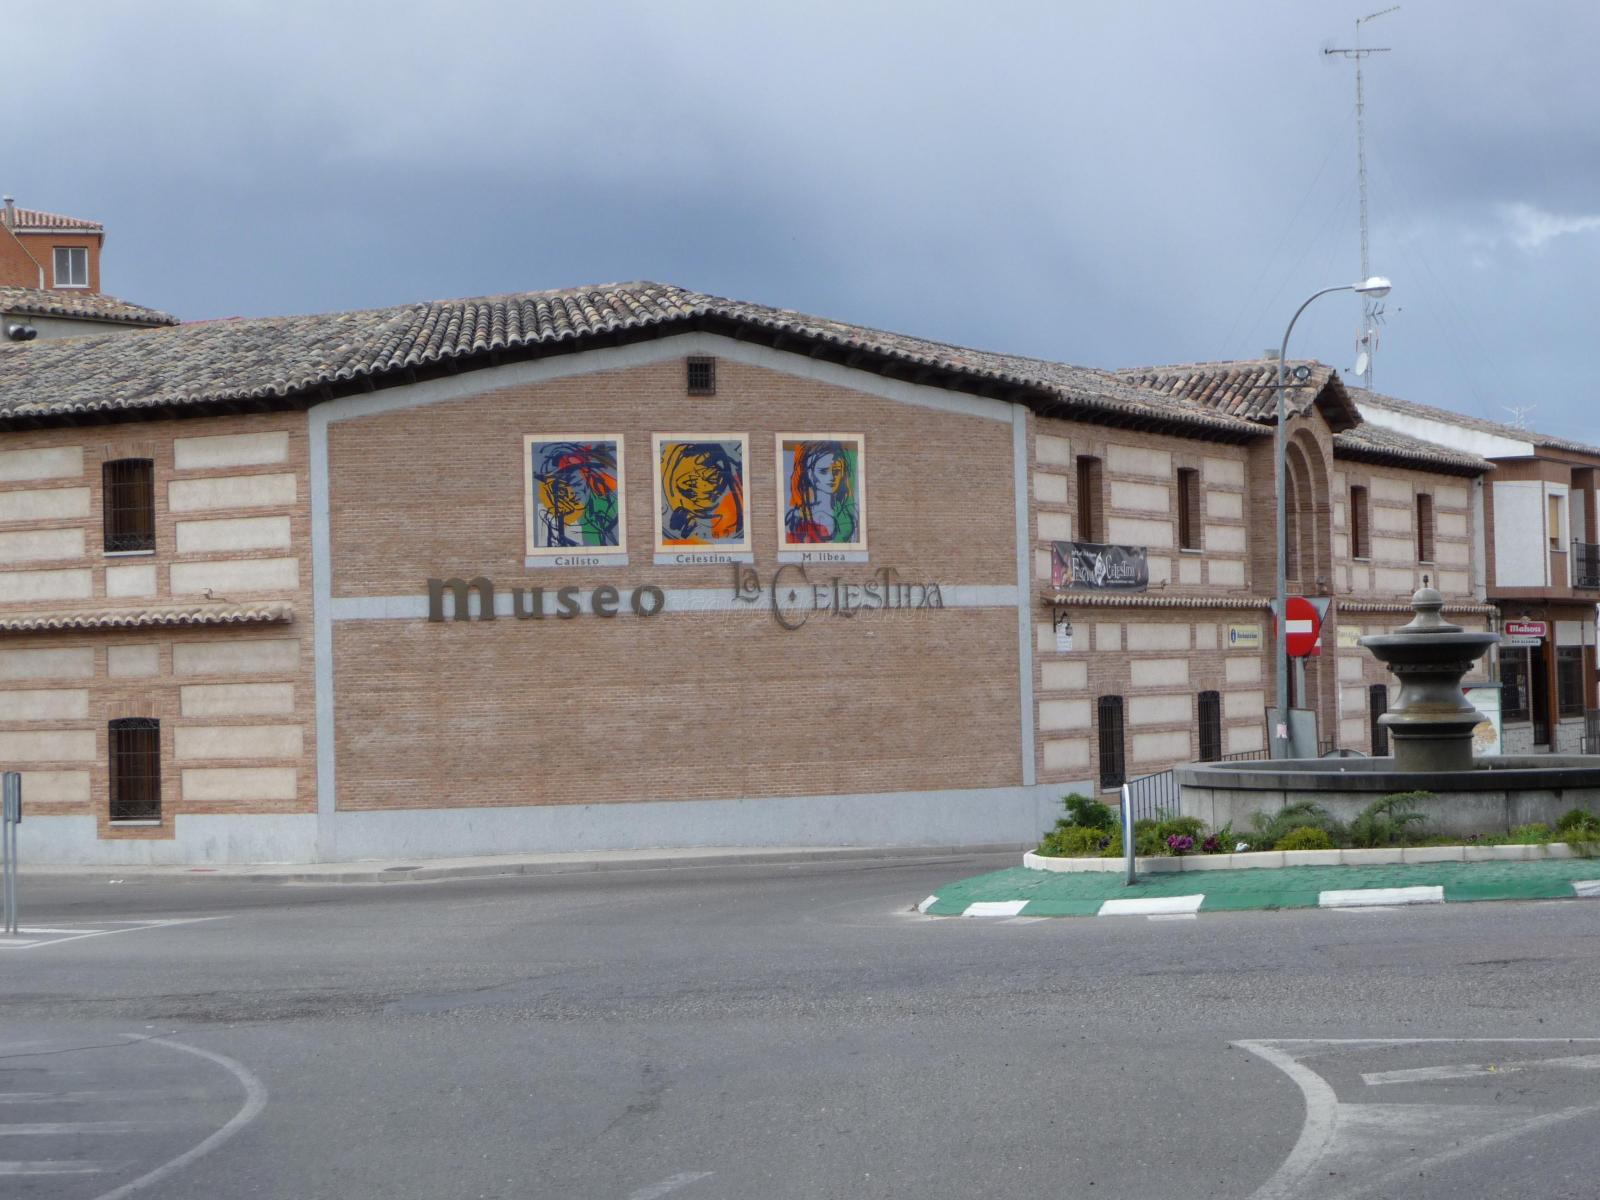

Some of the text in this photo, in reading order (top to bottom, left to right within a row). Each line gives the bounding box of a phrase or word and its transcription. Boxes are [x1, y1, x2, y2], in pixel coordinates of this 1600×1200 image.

[554, 556, 600, 566] Calisto
[675, 553, 732, 563] Celestina
[427, 576, 666, 622] museo
